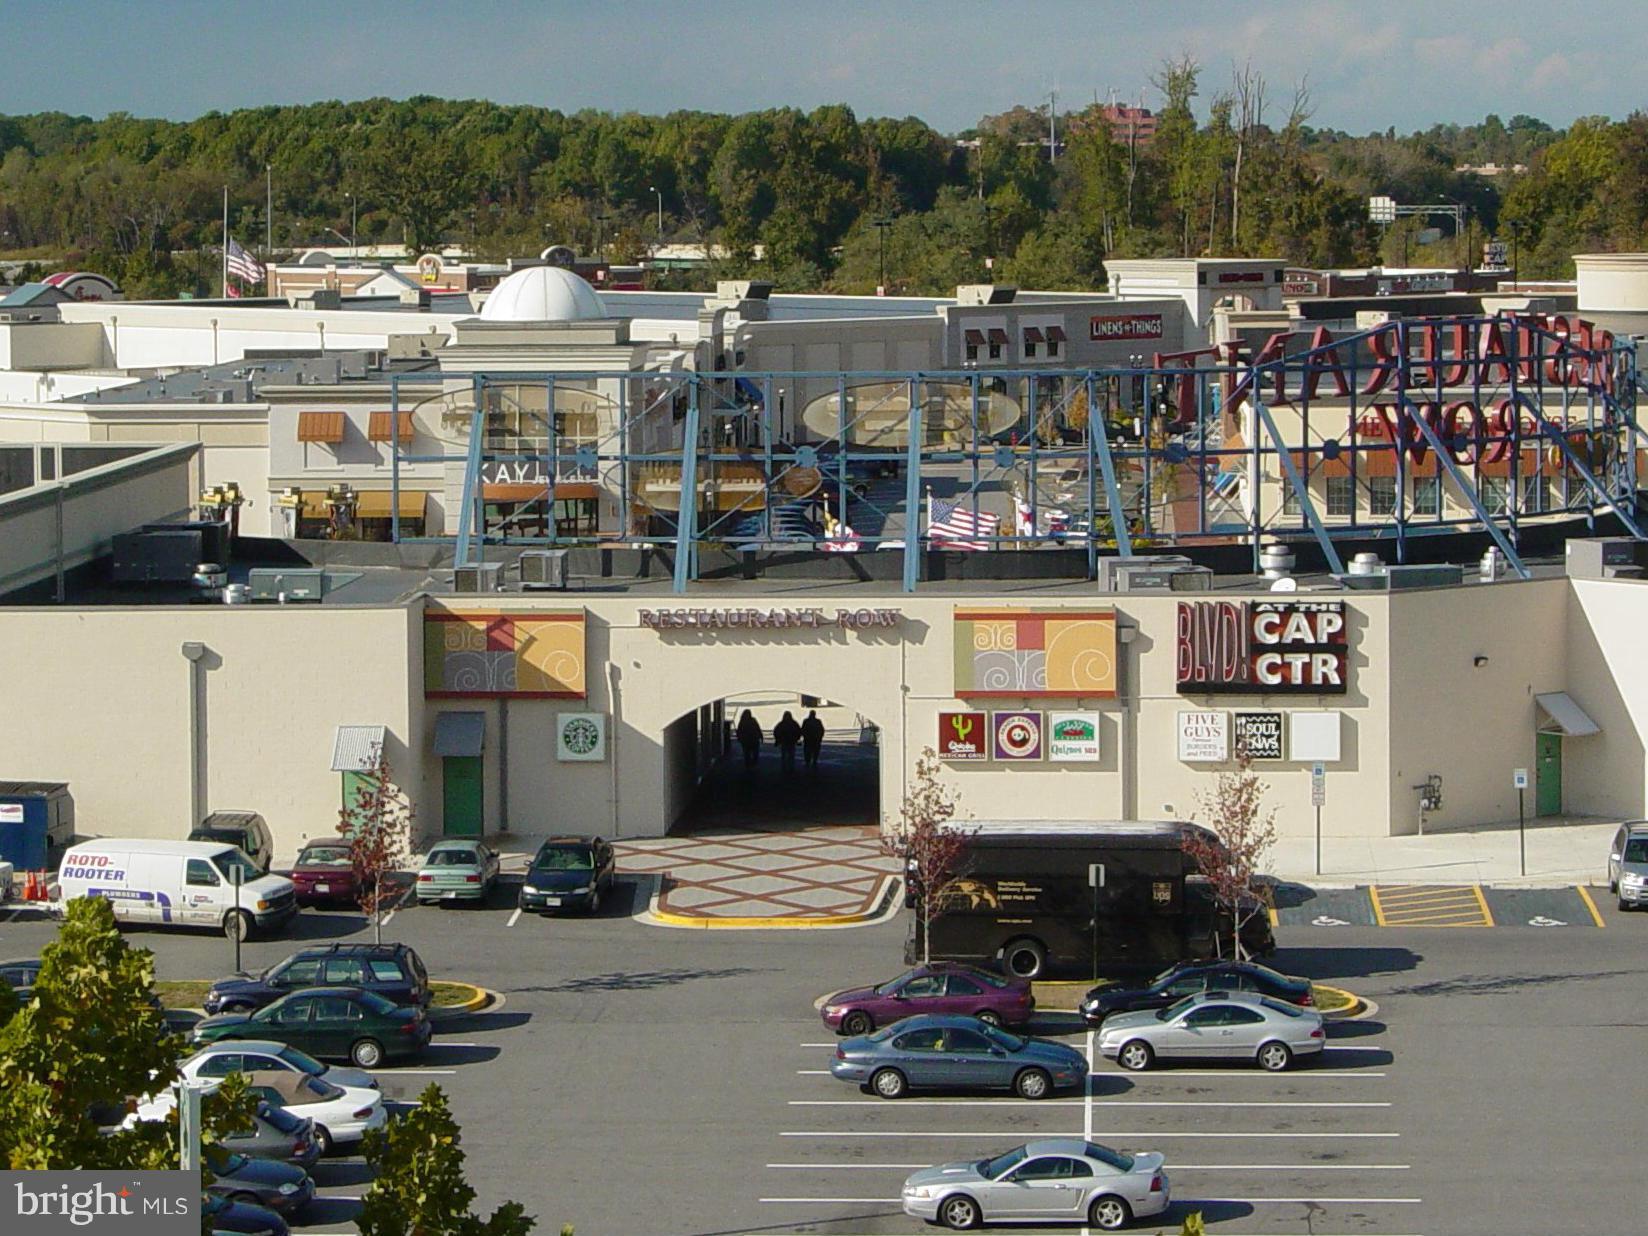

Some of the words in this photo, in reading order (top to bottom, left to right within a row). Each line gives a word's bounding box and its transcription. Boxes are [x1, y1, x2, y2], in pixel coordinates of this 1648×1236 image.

[1092, 321, 1123, 336] LINENS
[1131, 320, 1161, 334] THINGS
[1255, 603, 1288, 612] AT
[1294, 603, 1342, 612] THE
[638, 608, 823, 628] RESTAURANT
[836, 608, 901, 629] ROW
[1253, 612, 1343, 645] CAP
[1177, 601, 1247, 682] BLVD!
[1255, 652, 1342, 685] CTR
[1186, 714, 1219, 725] FIVE
[1184, 726, 1222, 737] GUYS
[1246, 722, 1280, 735] SOUL
[67, 854, 115, 867] ROTO-
[63, 867, 125, 881] ROOTER
